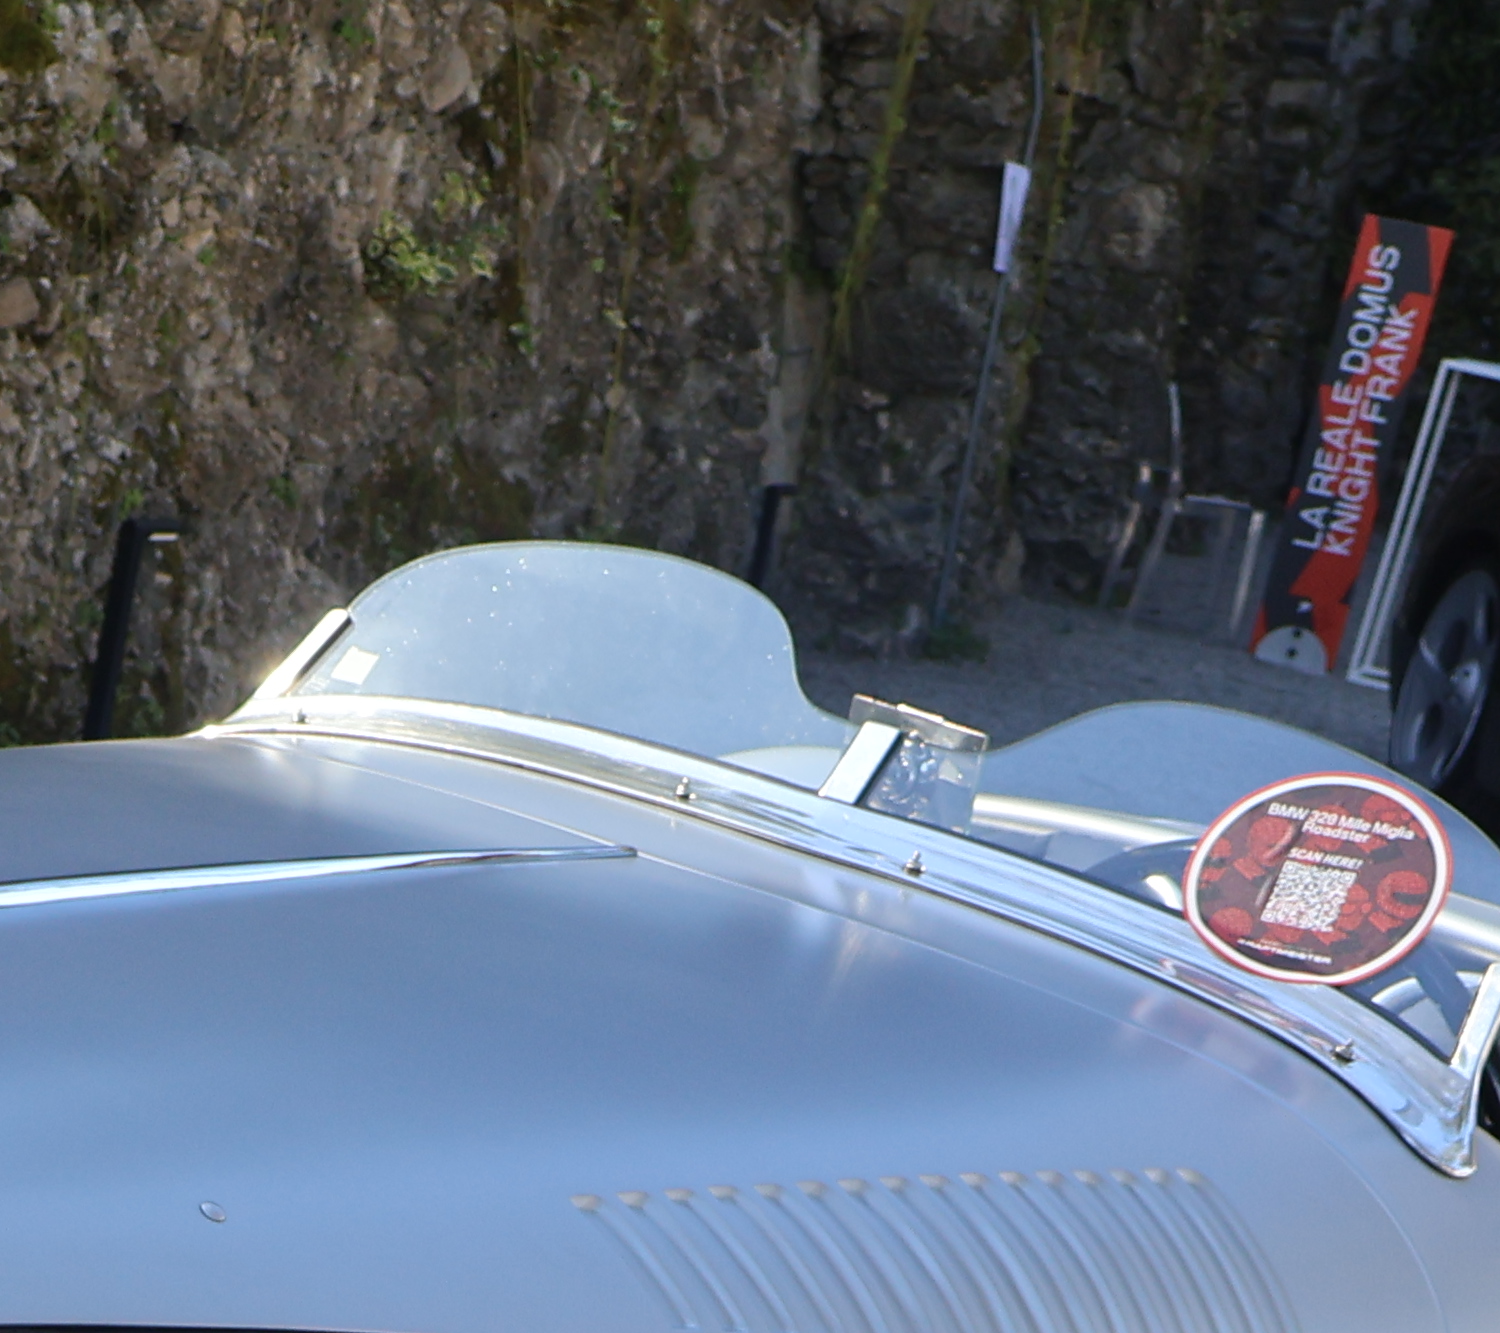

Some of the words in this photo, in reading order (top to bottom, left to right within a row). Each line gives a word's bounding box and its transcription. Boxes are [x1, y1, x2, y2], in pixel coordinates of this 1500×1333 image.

[1339, 243, 1401, 376] DOMUS
[1305, 379, 1364, 498] REALE
[1321, 429, 1383, 556] KNIGHT
[1359, 304, 1420, 425] FRANK
[1292, 506, 1330, 550] LA
[1267, 802, 1309, 820] BMW
[1337, 815, 1372, 832] Mille
[1371, 821, 1415, 840] Miglia
[1302, 821, 1371, 843] Roadster
[1287, 847, 1324, 862] SCAN
[1322, 854, 1364, 869] HERE!
